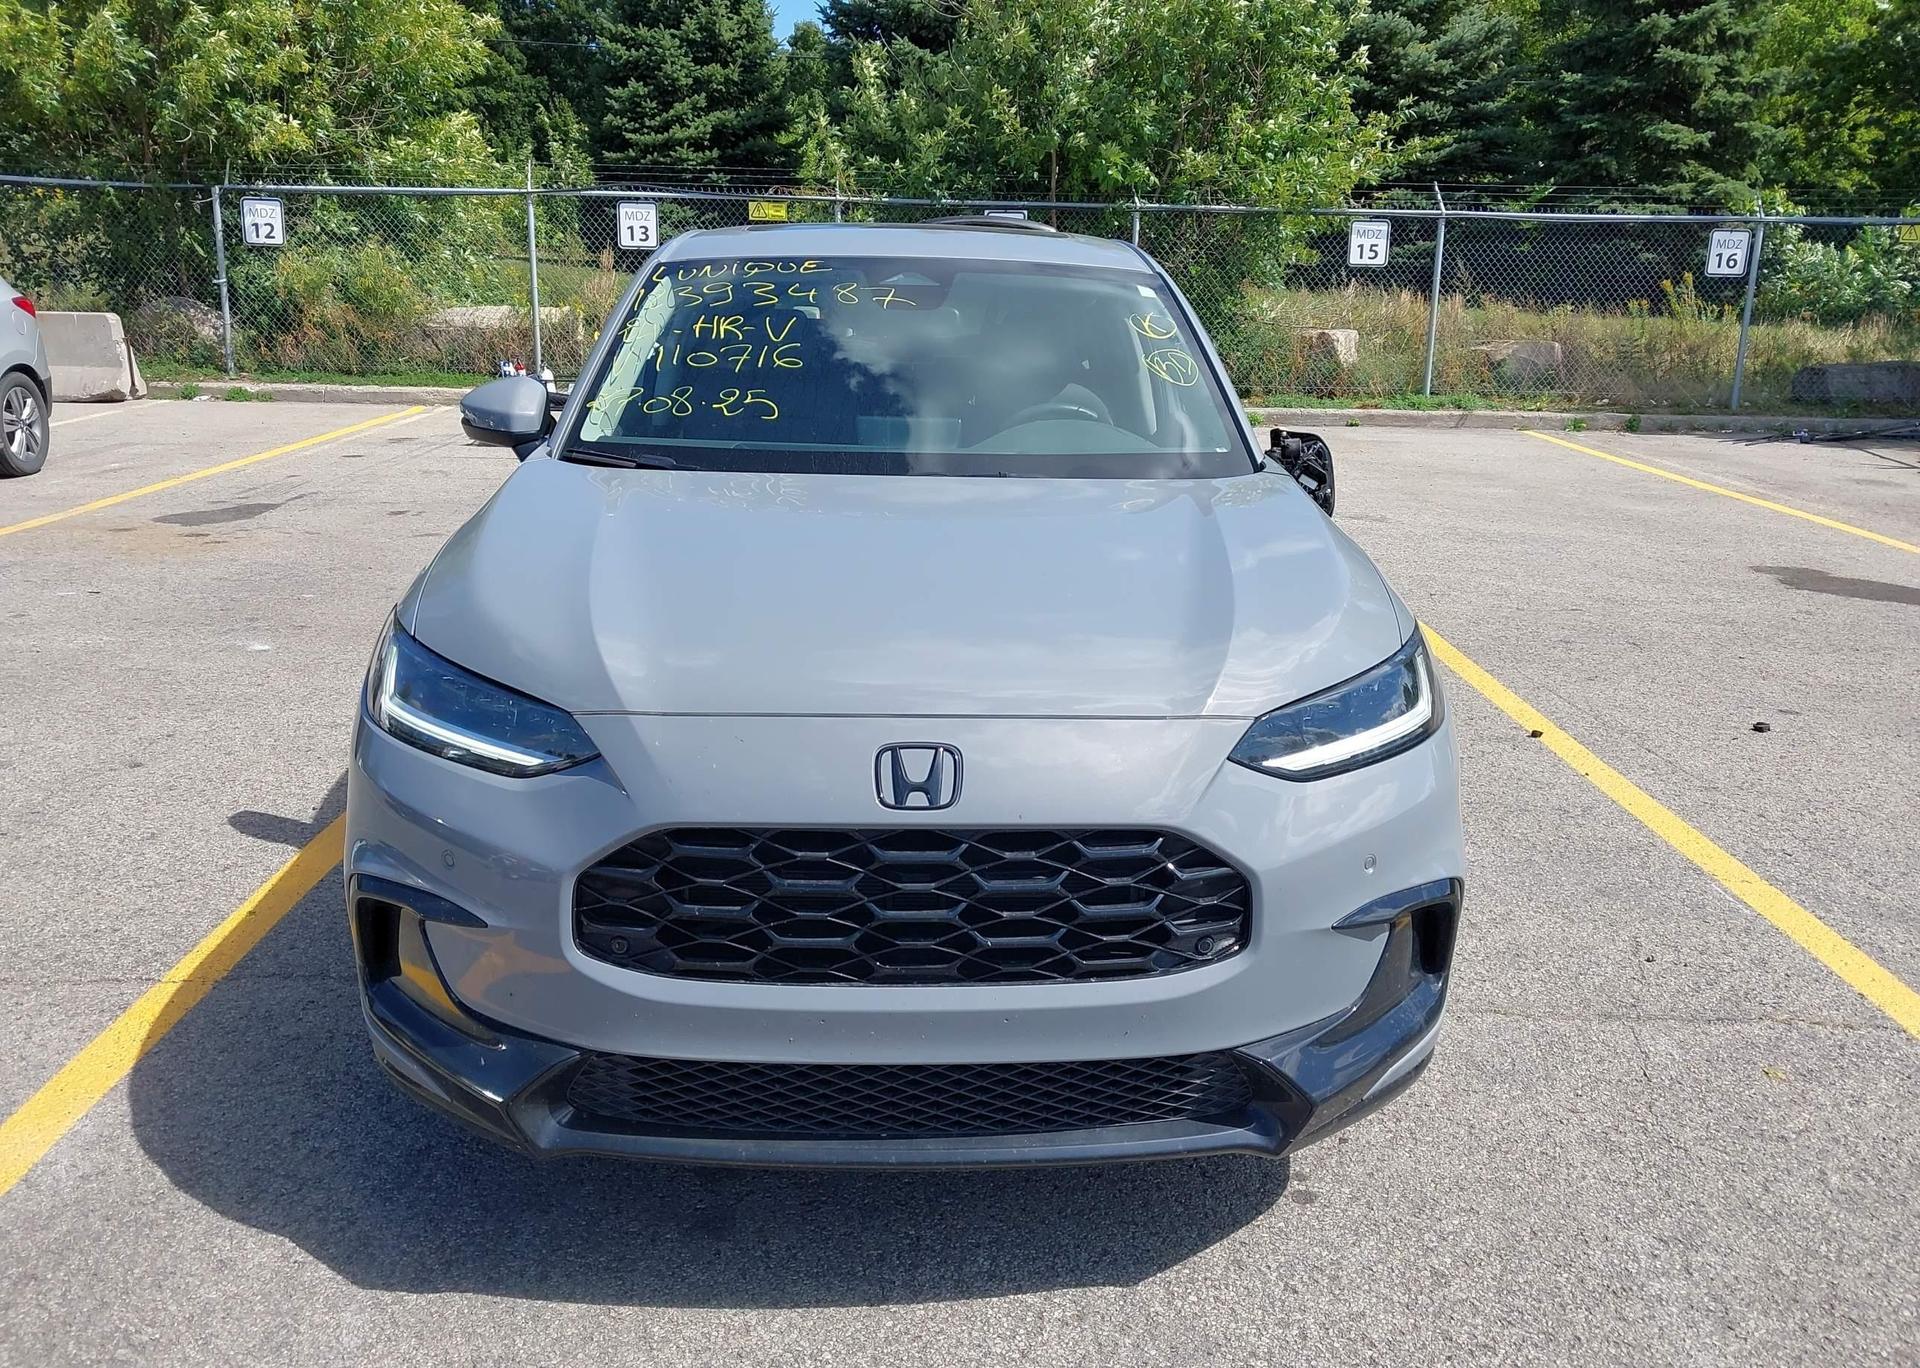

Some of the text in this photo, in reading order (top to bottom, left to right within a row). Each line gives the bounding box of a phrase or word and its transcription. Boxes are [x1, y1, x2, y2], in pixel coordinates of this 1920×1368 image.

[247, 207, 276, 219] MDZ
[624, 210, 652, 221] MDZ
[251, 222, 276, 239] 12
[626, 225, 650, 242] 13
[1356, 229, 1383, 240] MDZ
[1716, 238, 1743, 250] MDZ
[1357, 243, 1380, 260] 15
[1715, 252, 1739, 269] 16
